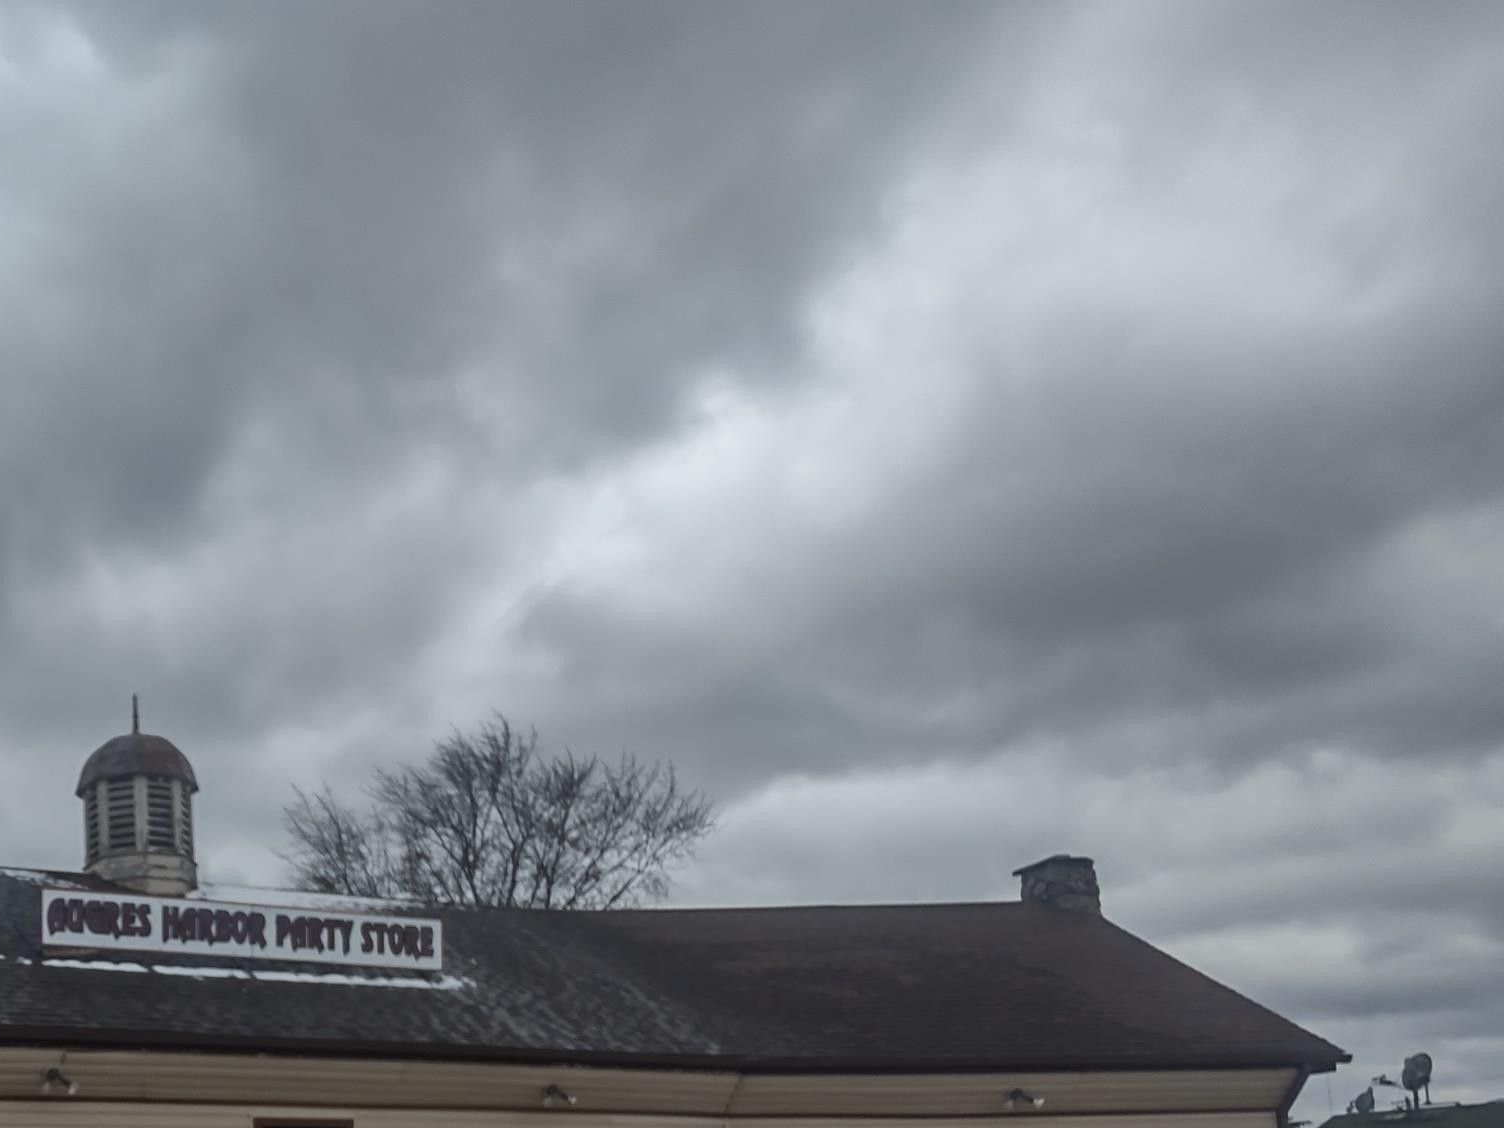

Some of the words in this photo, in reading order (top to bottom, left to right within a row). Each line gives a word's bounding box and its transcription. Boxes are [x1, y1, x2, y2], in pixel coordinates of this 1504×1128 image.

[162, 904, 267, 948] HARBOR
[276, 914, 354, 955] PARTY
[361, 921, 434, 961] STORE
